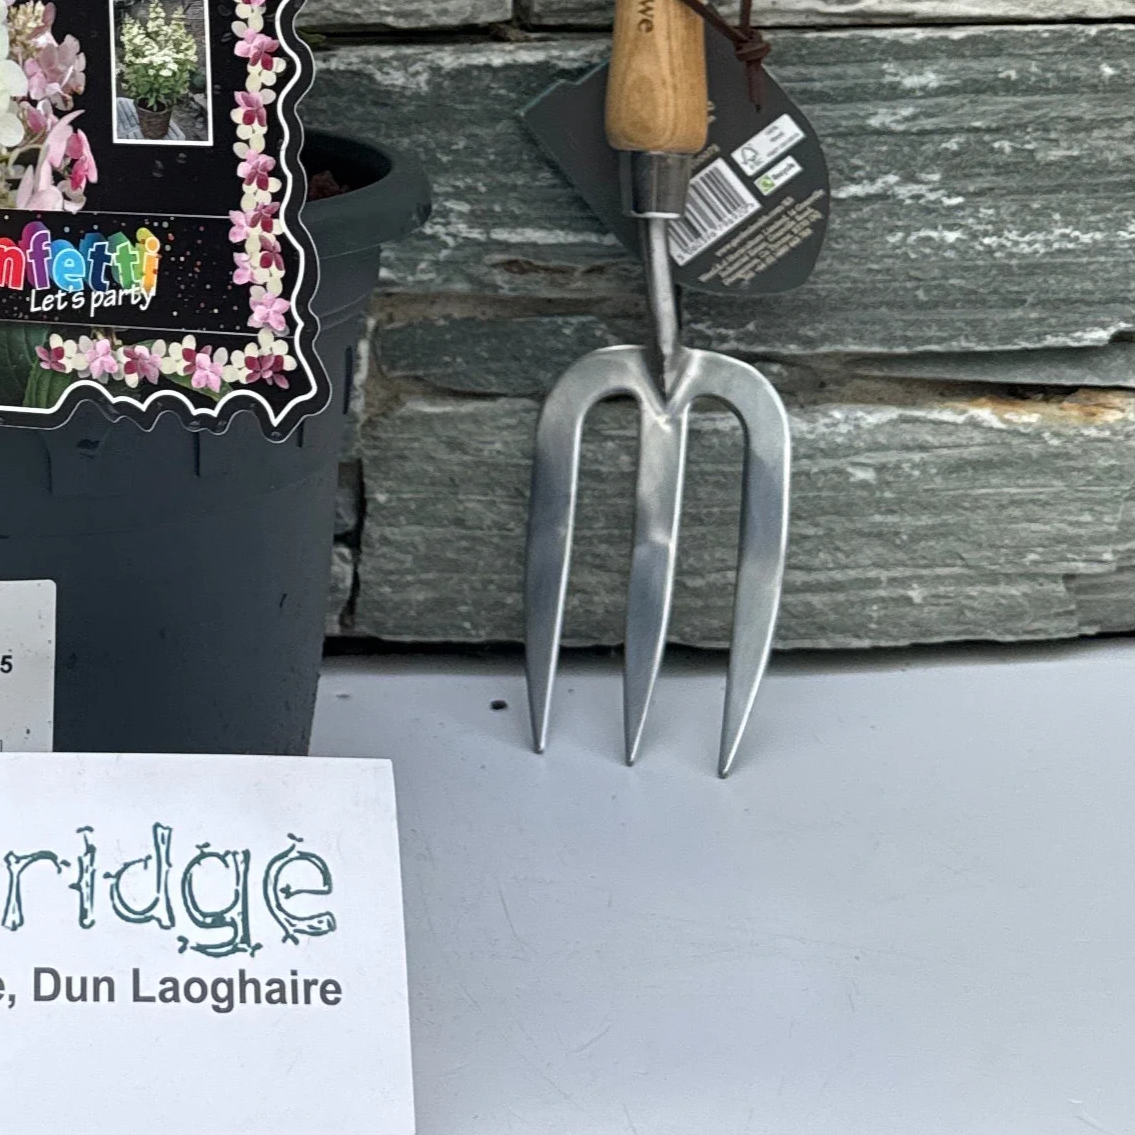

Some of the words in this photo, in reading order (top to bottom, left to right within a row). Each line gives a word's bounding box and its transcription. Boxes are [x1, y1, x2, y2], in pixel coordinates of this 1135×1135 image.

[30, 285, 86, 313] Let's
[90, 283, 155, 317] party
[32, 967, 116, 1003] Dun
[132, 968, 343, 1014] Laoghaire
